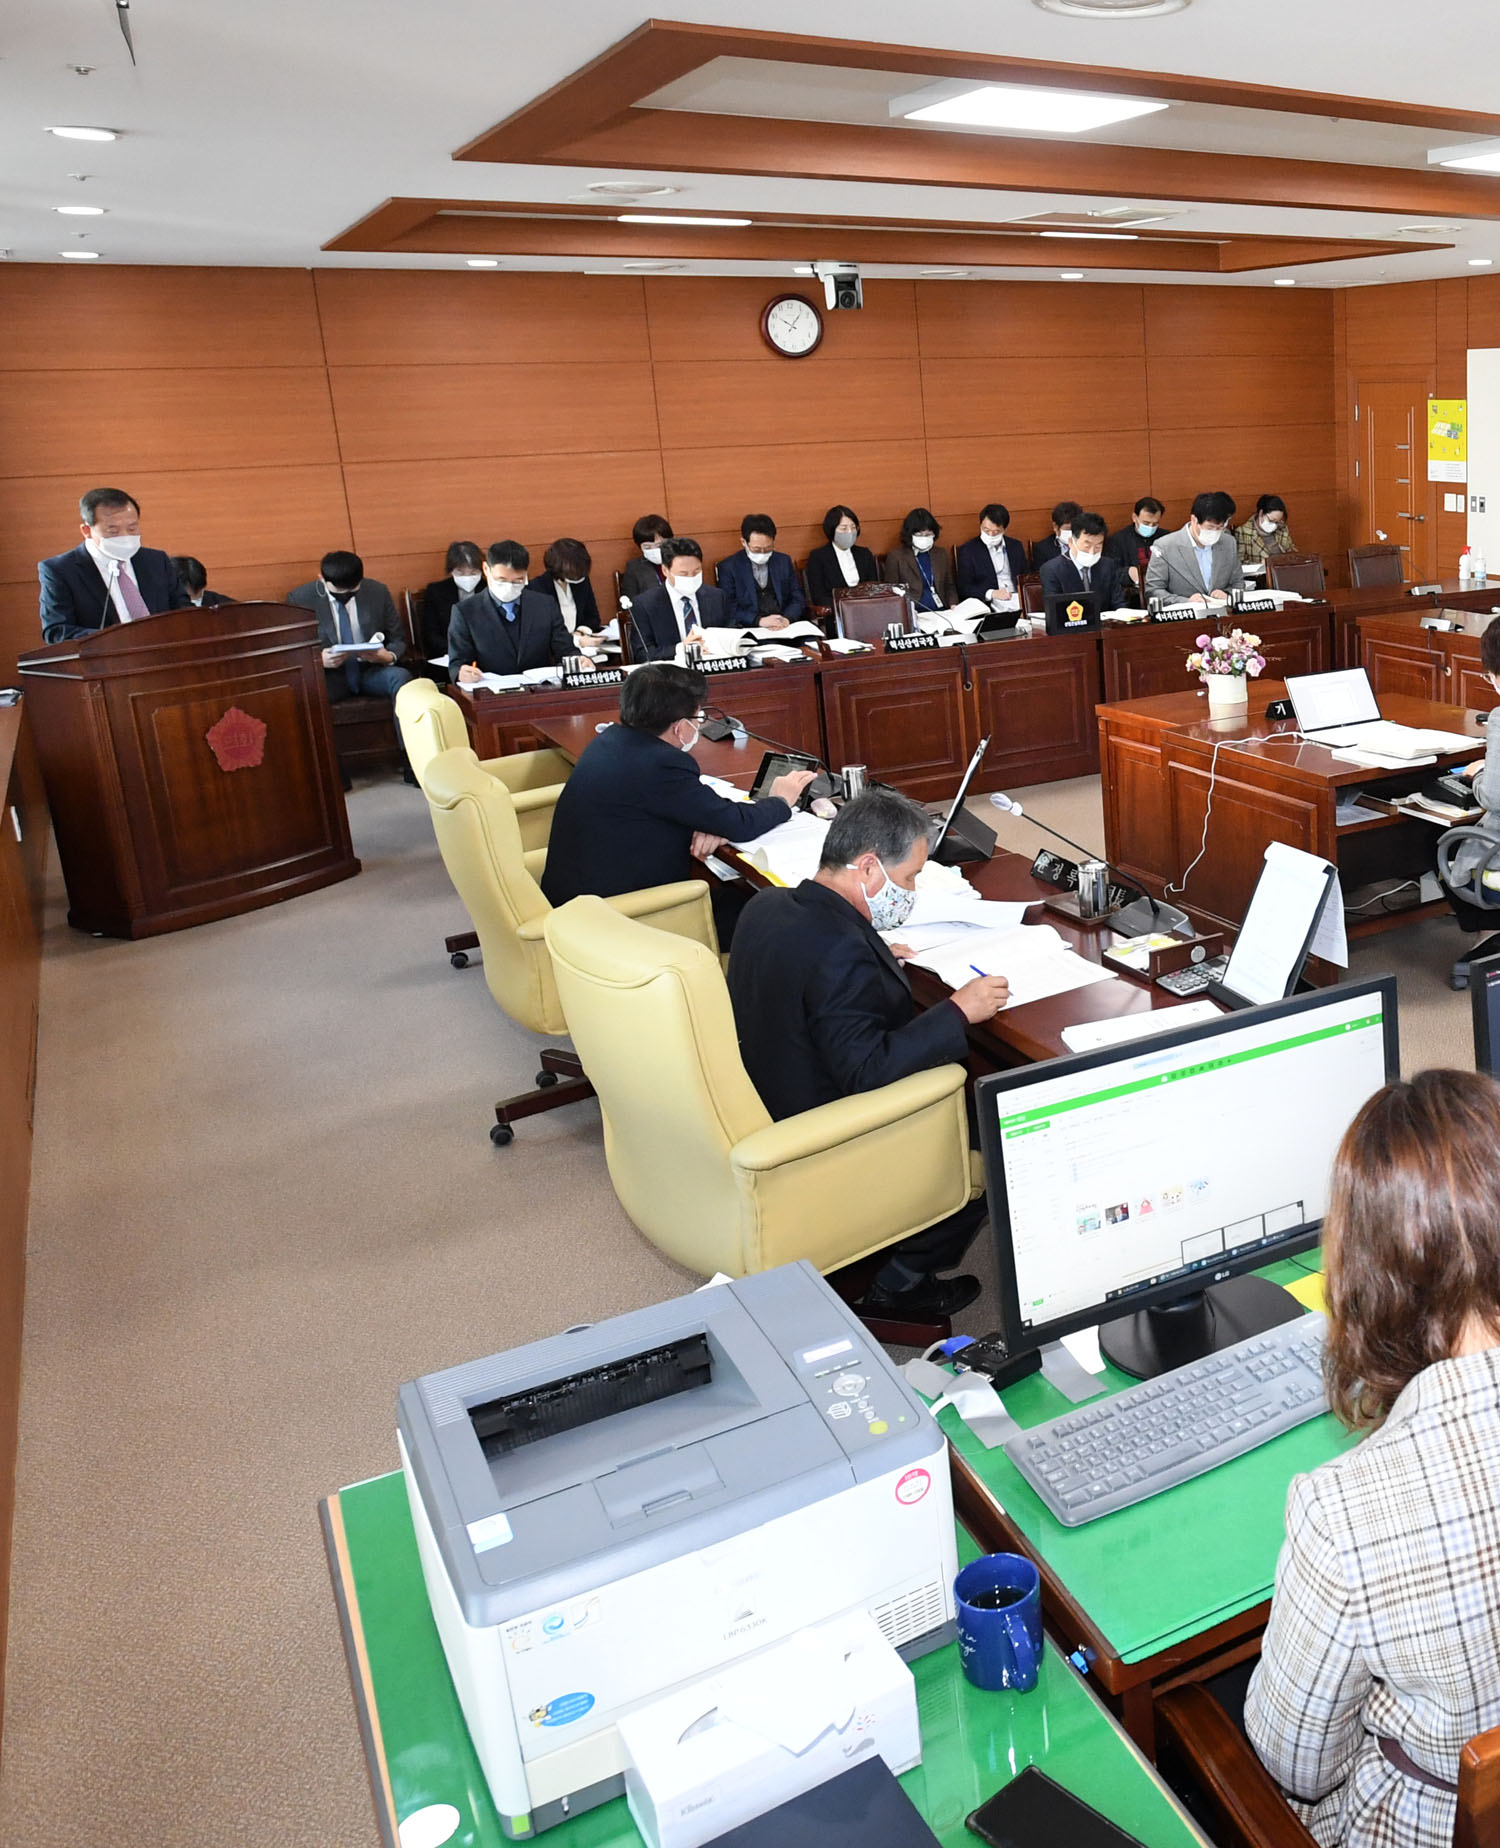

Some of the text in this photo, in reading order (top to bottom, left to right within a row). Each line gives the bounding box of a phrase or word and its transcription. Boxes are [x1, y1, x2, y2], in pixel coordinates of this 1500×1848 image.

[889, 637, 935, 651] 혁신산업국장
[695, 657, 747, 673] 미래신산업과장
[566, 671, 622, 687] 자동차조선산업과장
